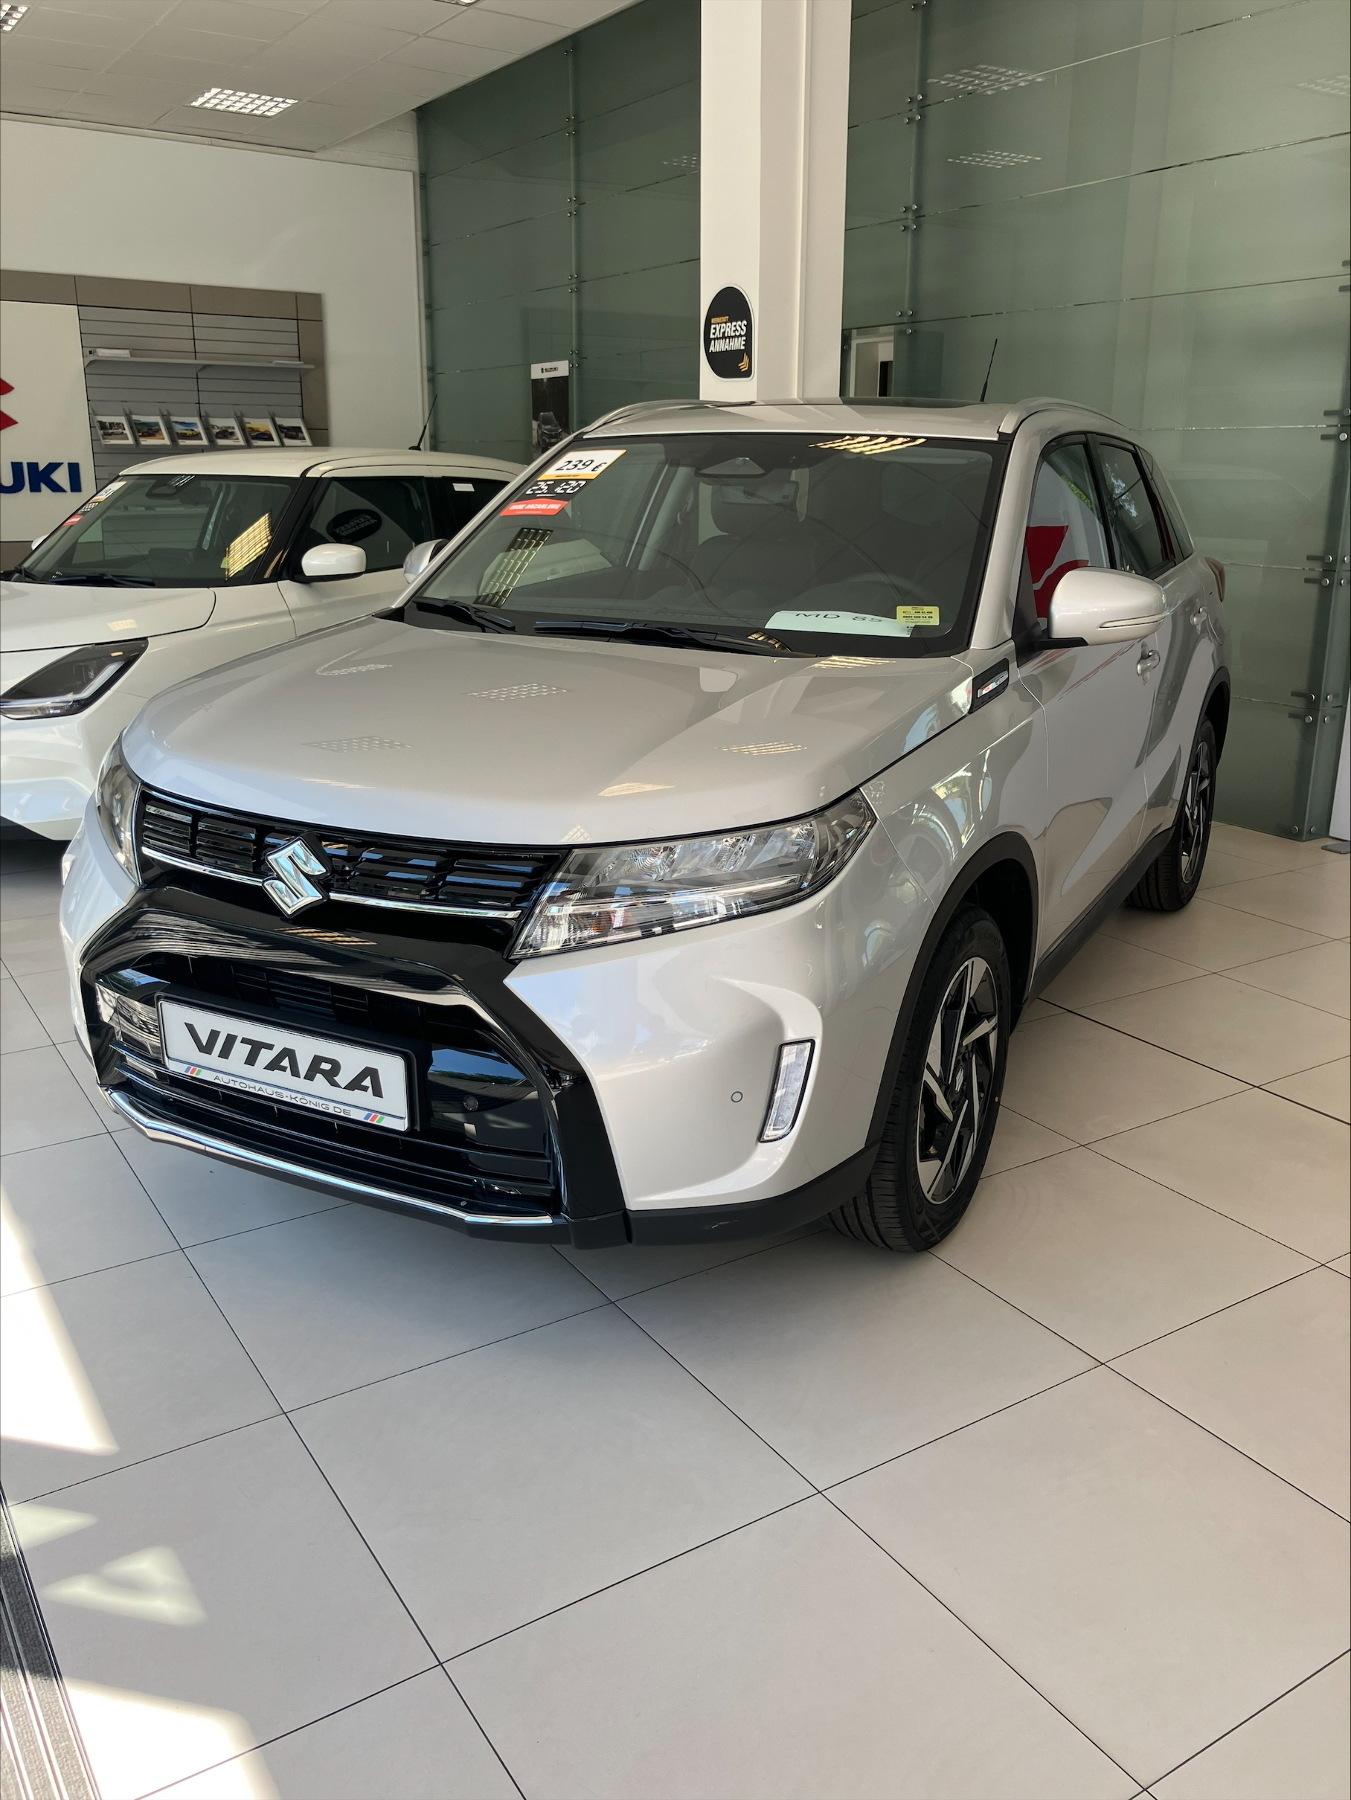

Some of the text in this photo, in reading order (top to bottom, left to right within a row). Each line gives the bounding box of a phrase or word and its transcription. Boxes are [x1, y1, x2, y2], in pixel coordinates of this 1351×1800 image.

[710, 320, 747, 339] EXPRESS
[709, 336, 746, 353] ANNAHME
[556, 460, 607, 472] 239 €
[184, 1022, 384, 1099] VITARA
